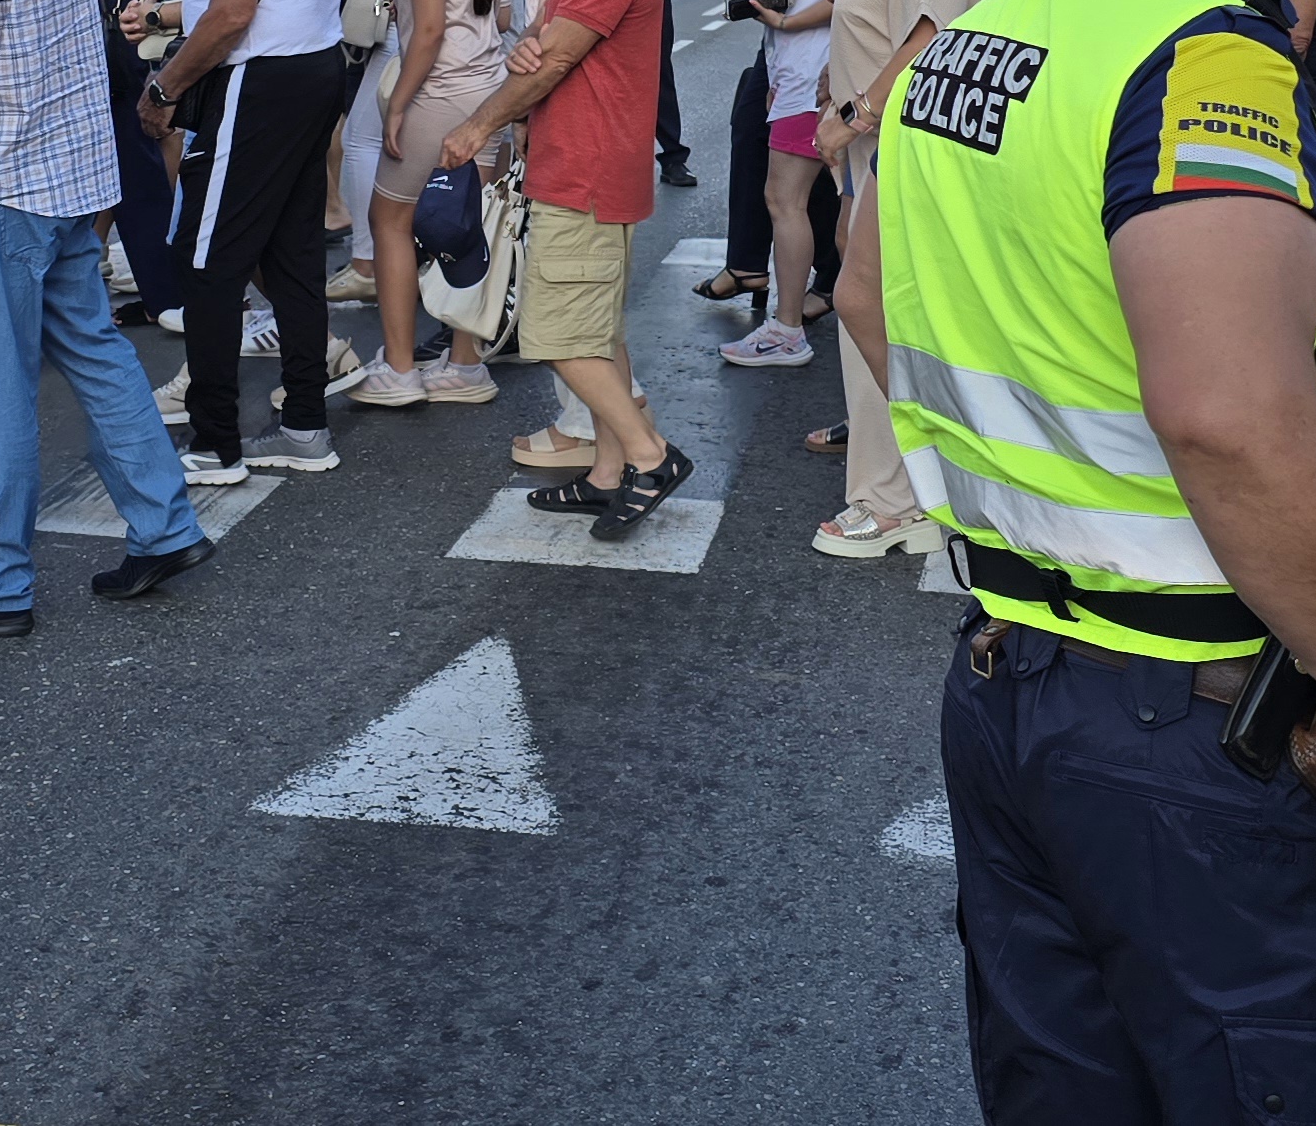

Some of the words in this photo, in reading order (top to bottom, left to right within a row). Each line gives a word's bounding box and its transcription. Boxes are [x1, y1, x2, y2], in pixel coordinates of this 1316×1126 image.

[913, 30, 1041, 94] TRAFFIC
[902, 72, 1005, 146] POLICE
[1197, 101, 1280, 129] TRAFFIC
[1178, 119, 1293, 158] POLICE
